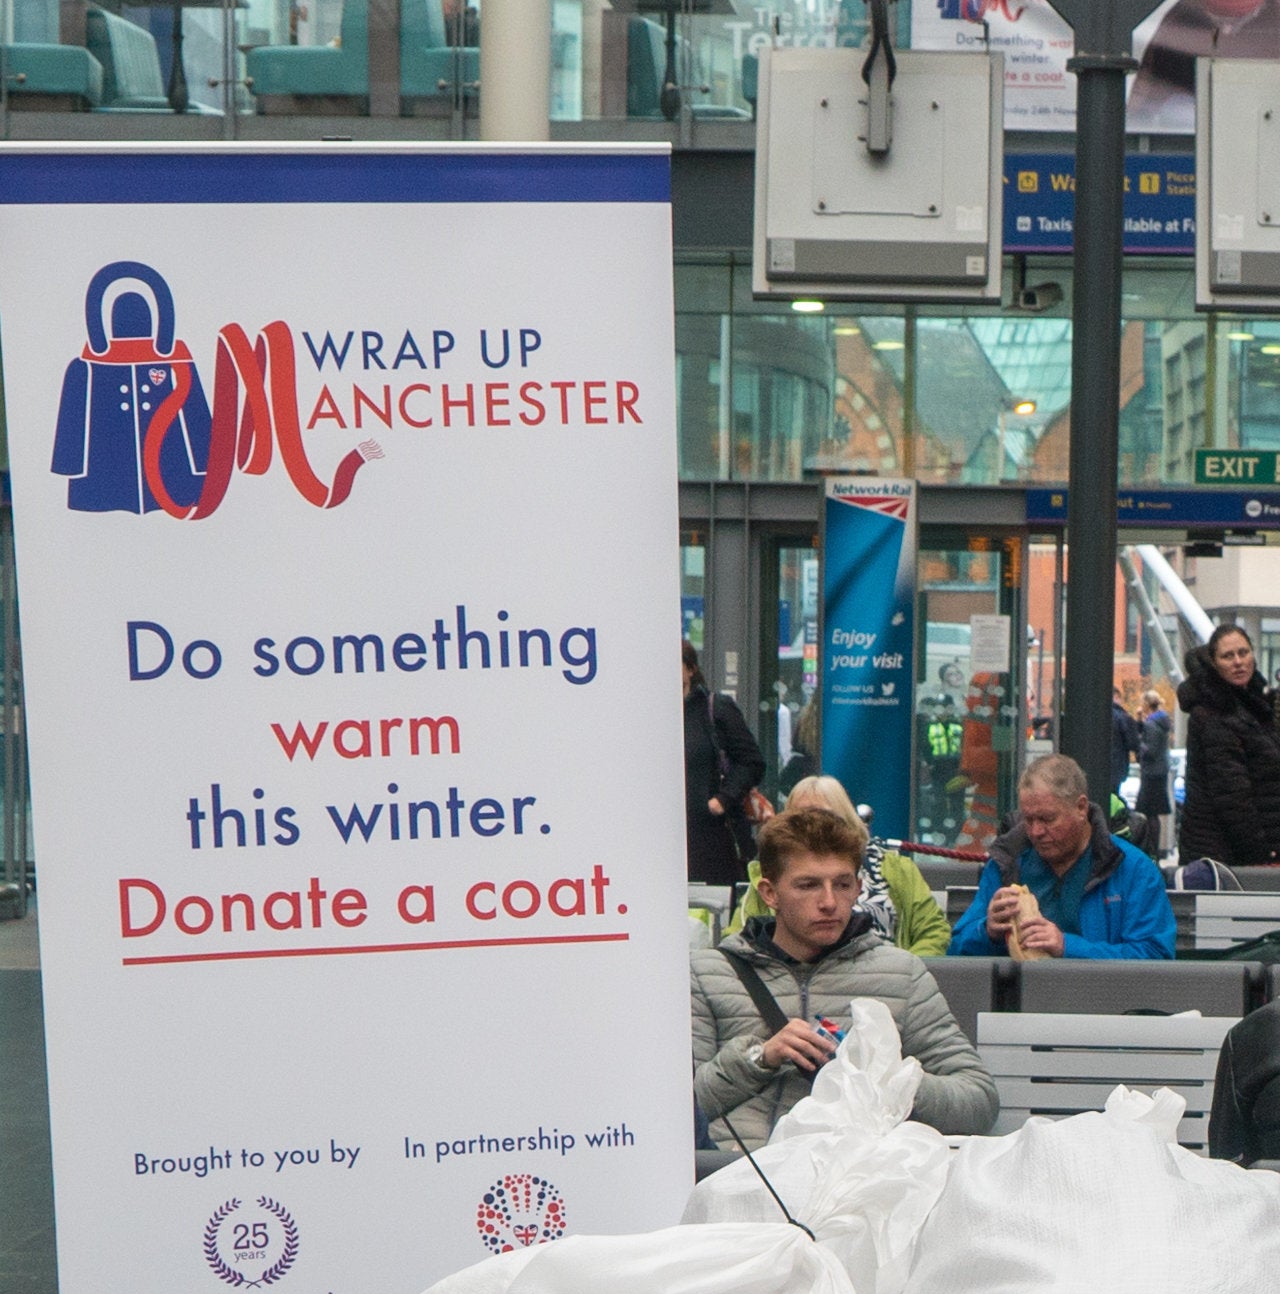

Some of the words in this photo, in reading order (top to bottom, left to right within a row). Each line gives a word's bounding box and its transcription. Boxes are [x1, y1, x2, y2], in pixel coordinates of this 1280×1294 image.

[1124, 217, 1162, 233] ilable
[302, 329, 455, 372] WRAP
[480, 329, 541, 369] UP
[1205, 456, 1259, 478] EXIT
[832, 484, 912, 496] NetworkRail
[127, 621, 222, 681] Do
[253, 605, 597, 685] something
[832, 628, 877, 650] Enjoy
[831, 655, 868, 671] your
[872, 653, 904, 669] visit
[271, 716, 460, 762] warm
[186, 784, 300, 849] this
[326, 783, 551, 844] winter.
[119, 878, 367, 938] Donate
[398, 885, 435, 924] a
[466, 865, 627, 920] coat.
[135, 1146, 232, 1177] Brought
[241, 1149, 264, 1167] to
[274, 1149, 319, 1172] you
[331, 1139, 360, 1168] by
[405, 1137, 425, 1158] In
[436, 1127, 575, 1163] partnership
[585, 1123, 634, 1147] with
[233, 1223, 269, 1250] 25
[233, 1250, 268, 1264] years
